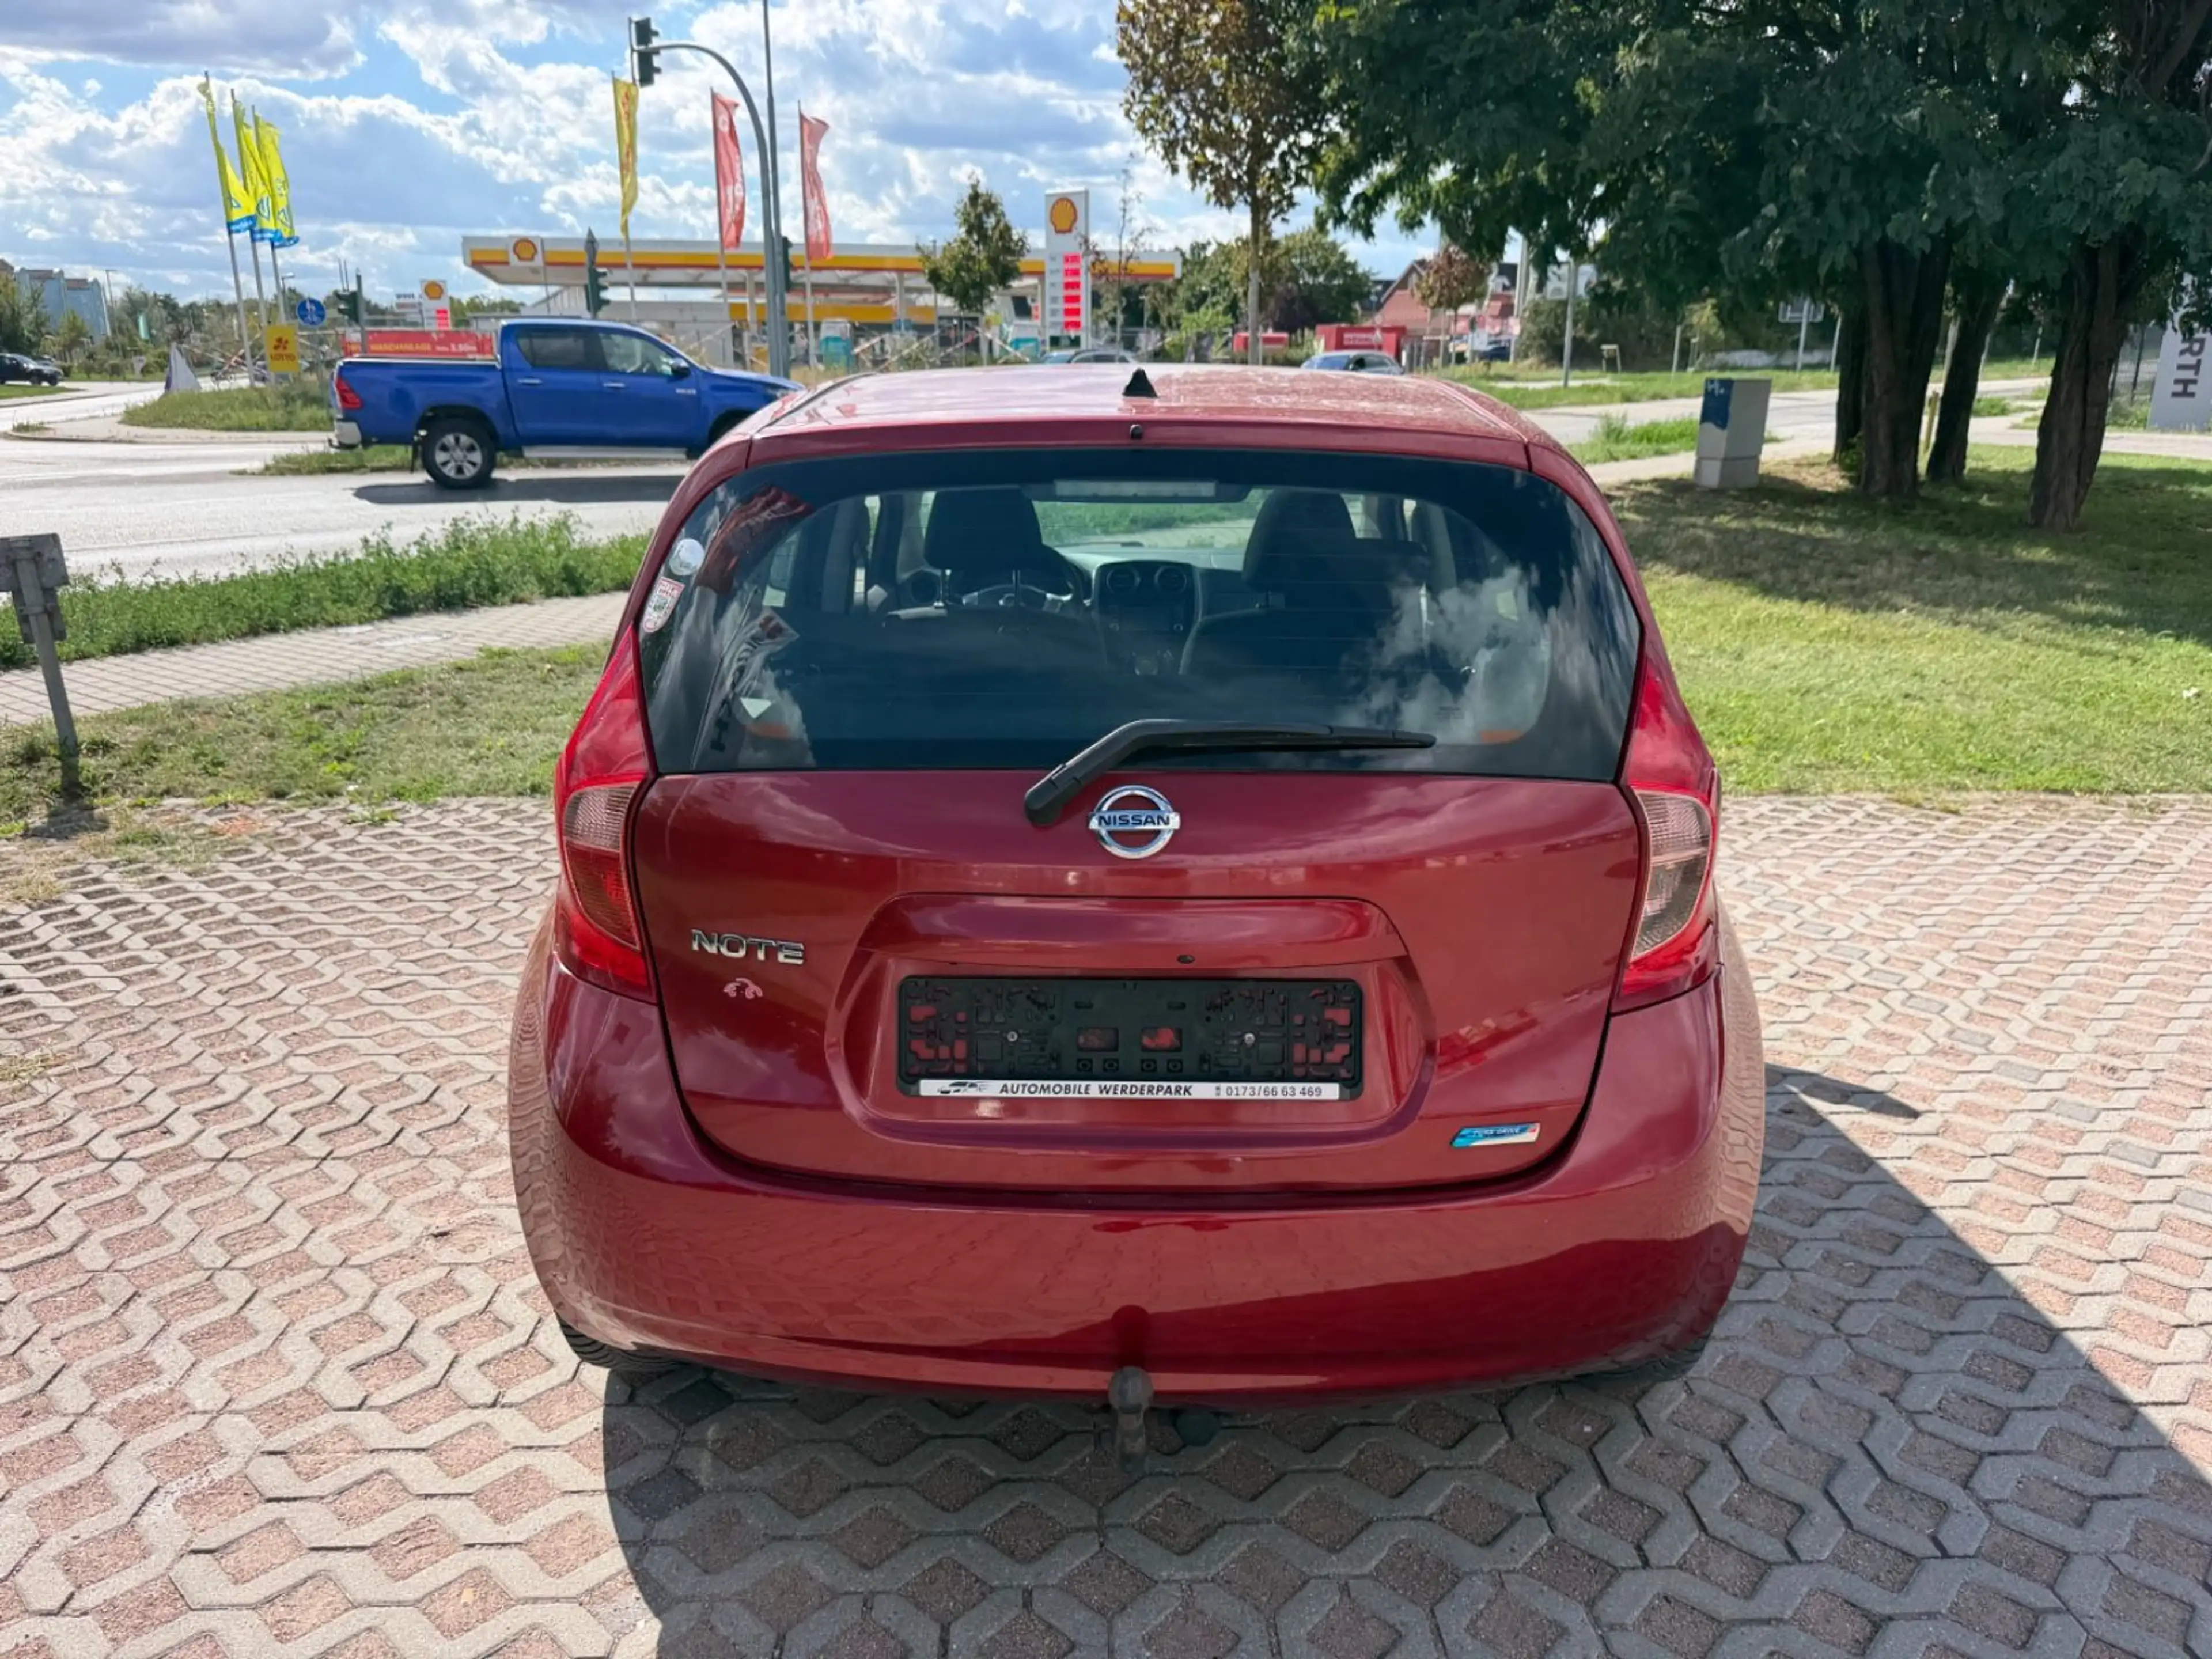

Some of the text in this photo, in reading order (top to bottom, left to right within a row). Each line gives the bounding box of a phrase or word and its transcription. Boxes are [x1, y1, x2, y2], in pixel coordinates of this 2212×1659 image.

[2171, 333, 2206, 398] RTH
[1097, 813, 1171, 827] NISSAN
[691, 929, 805, 965] NOTE
[999, 1083, 1323, 1097] AUTOMOBILE WERDERPARK 0173/66 63 469
